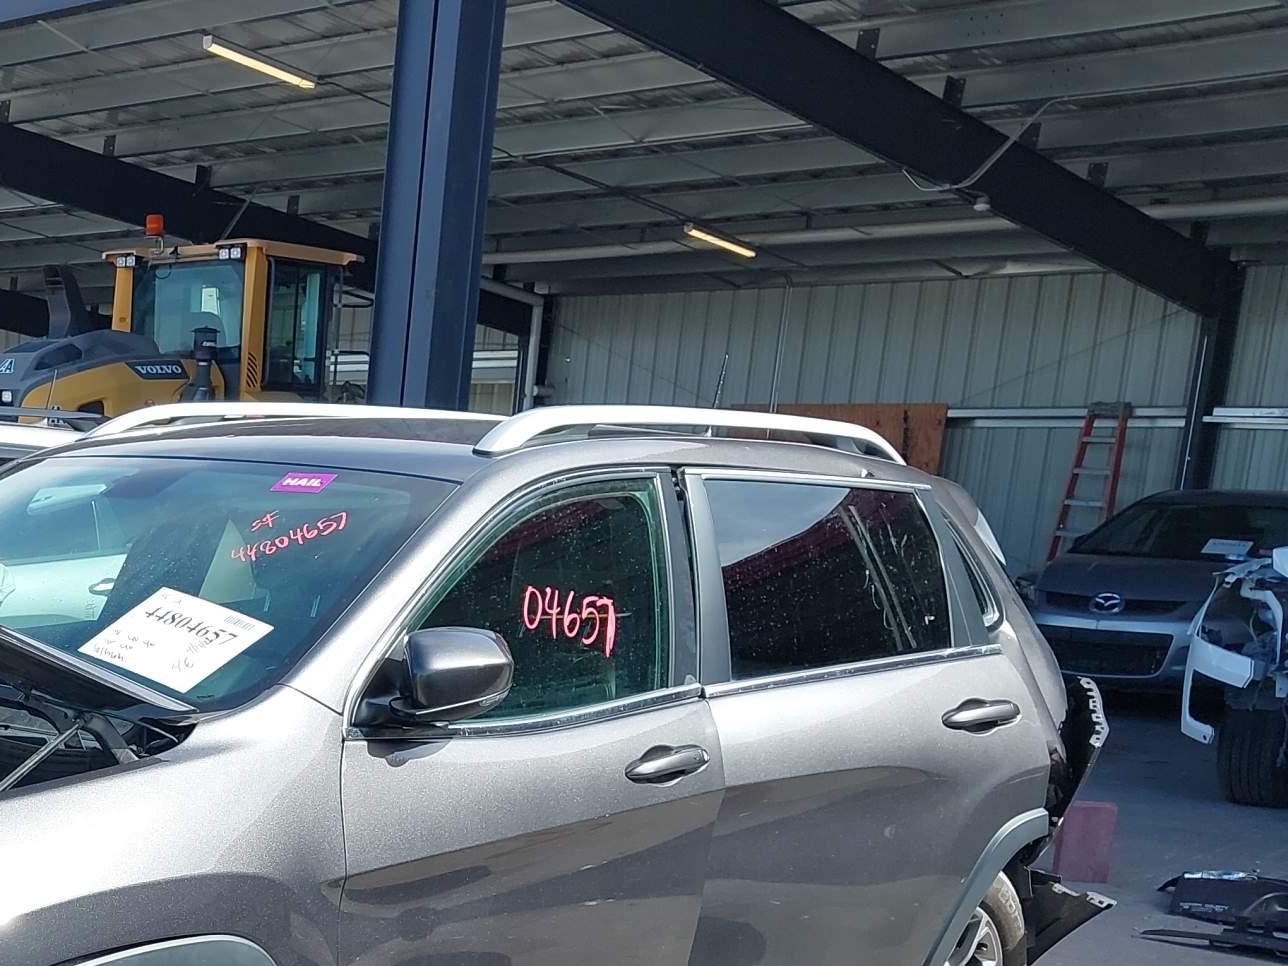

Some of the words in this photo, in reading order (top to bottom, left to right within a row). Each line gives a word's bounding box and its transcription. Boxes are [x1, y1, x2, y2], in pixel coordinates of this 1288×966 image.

[135, 364, 182, 374] VOLVO
[281, 477, 322, 487] HAIL
[231, 511, 348, 562] 44804657
[144, 605, 239, 646] 44804657
[522, 584, 617, 657] 04657
